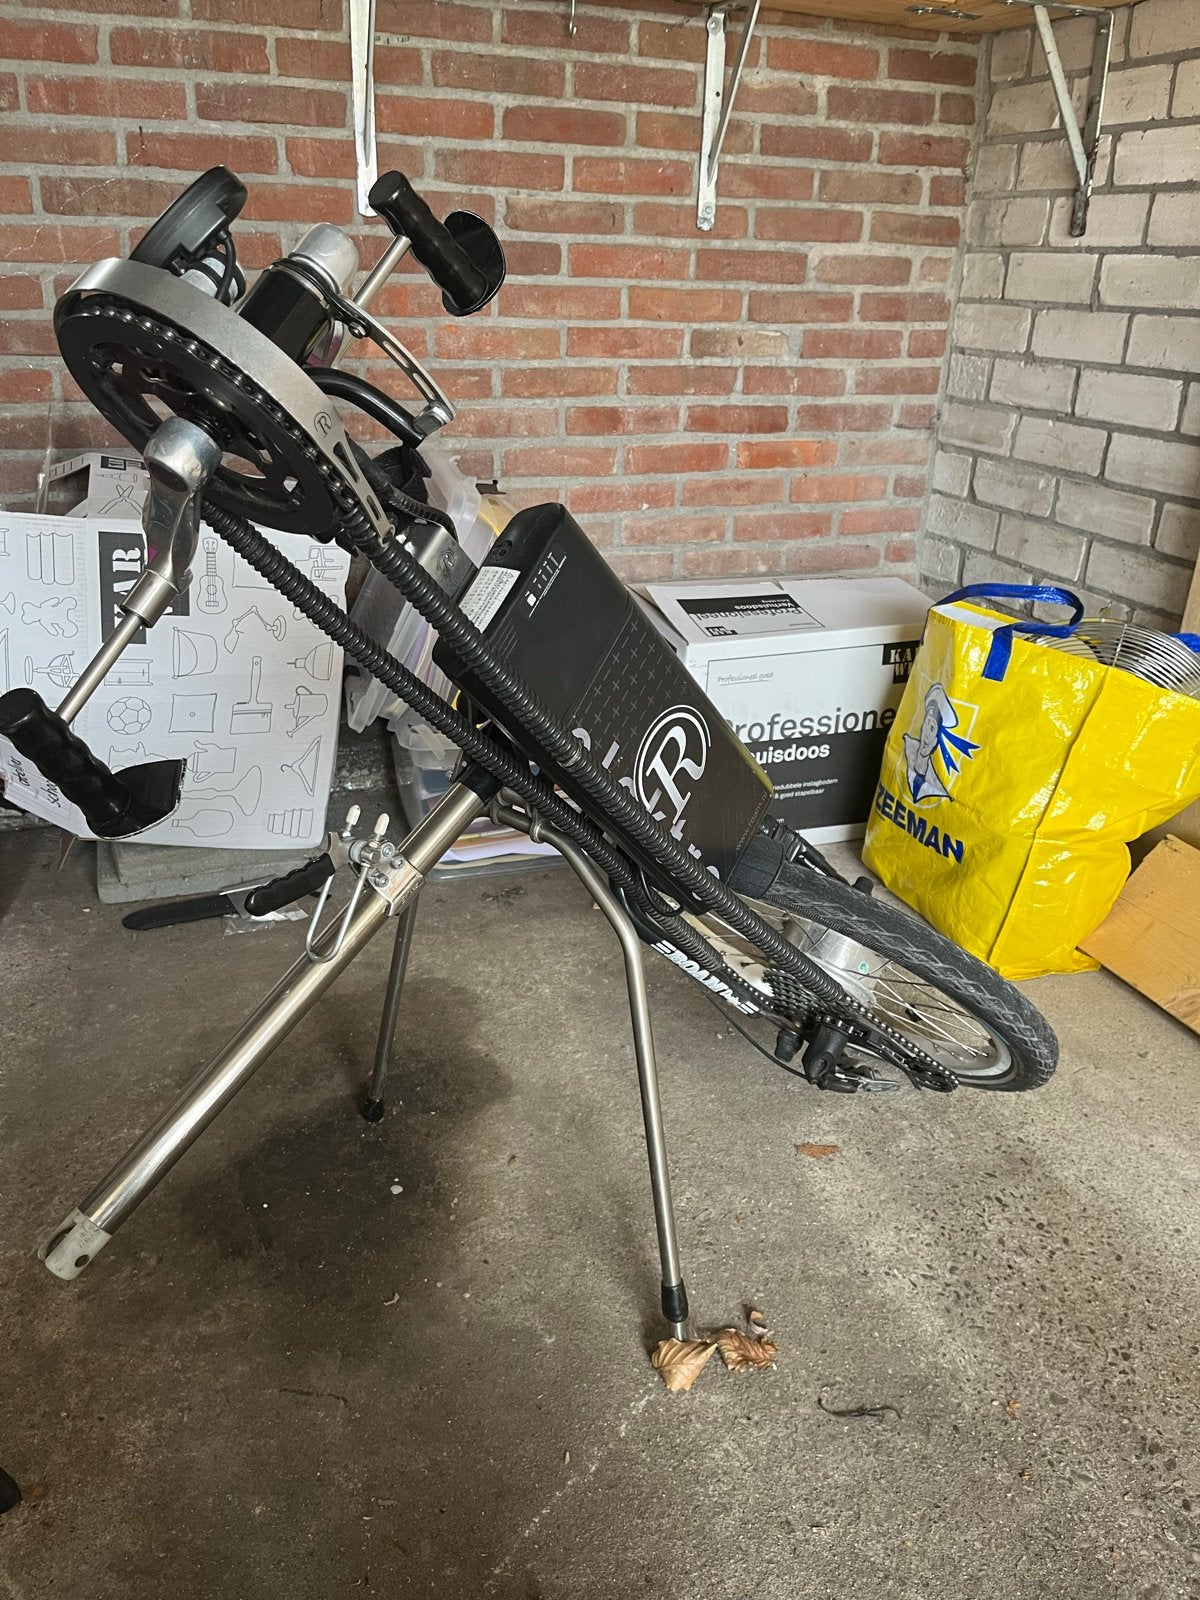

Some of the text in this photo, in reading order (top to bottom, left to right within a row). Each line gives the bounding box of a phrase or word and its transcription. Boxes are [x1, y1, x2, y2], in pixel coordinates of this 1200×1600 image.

[697, 607, 803, 621] Professioneel
[725, 707, 897, 744] rofessione
[750, 743, 831, 765] uisdoos
